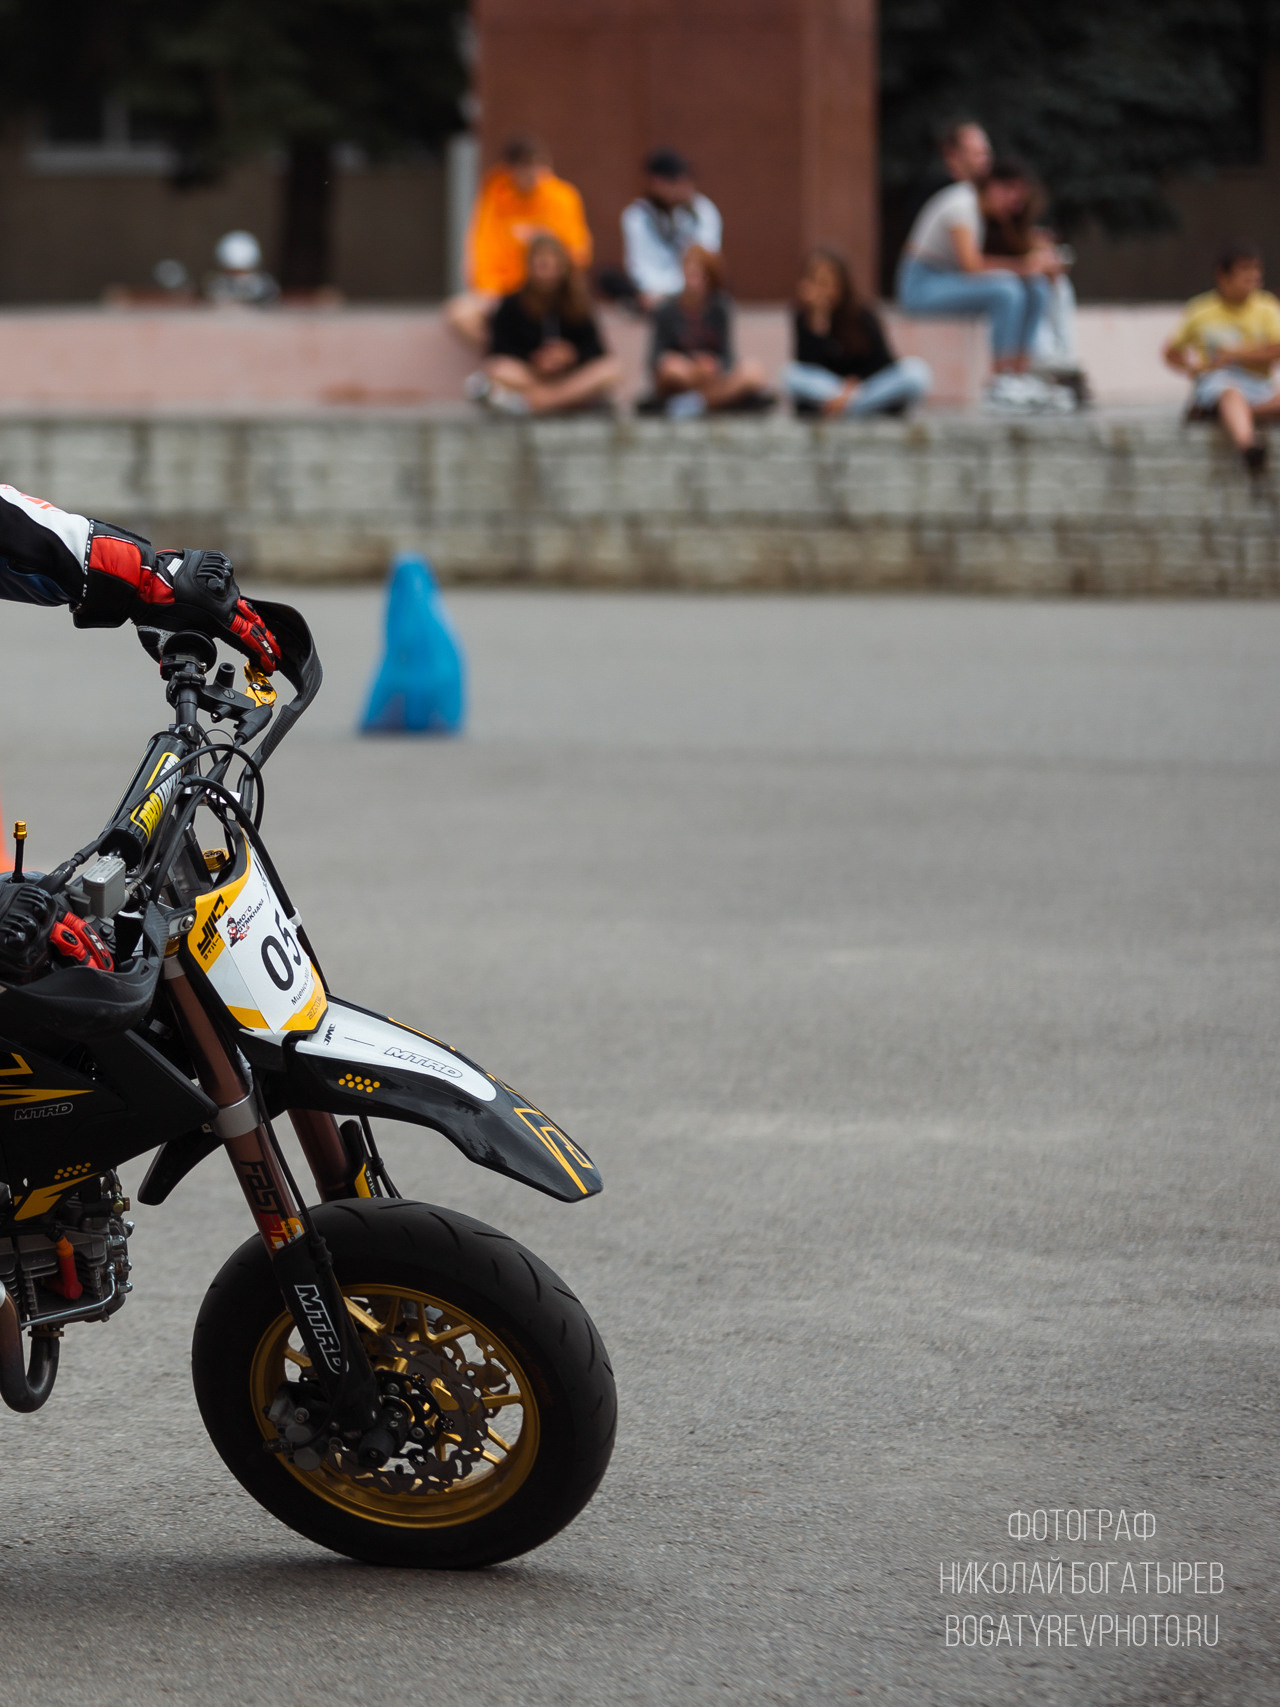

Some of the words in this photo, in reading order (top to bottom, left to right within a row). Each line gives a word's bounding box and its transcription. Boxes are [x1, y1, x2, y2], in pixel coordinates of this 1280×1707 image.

[235, 905, 253, 928] MOTO
[260, 908, 302, 992] 05
[384, 1047, 463, 1079] MTRD
[14, 1102, 74, 1121] MTRD
[295, 1284, 349, 1374] MTRD
